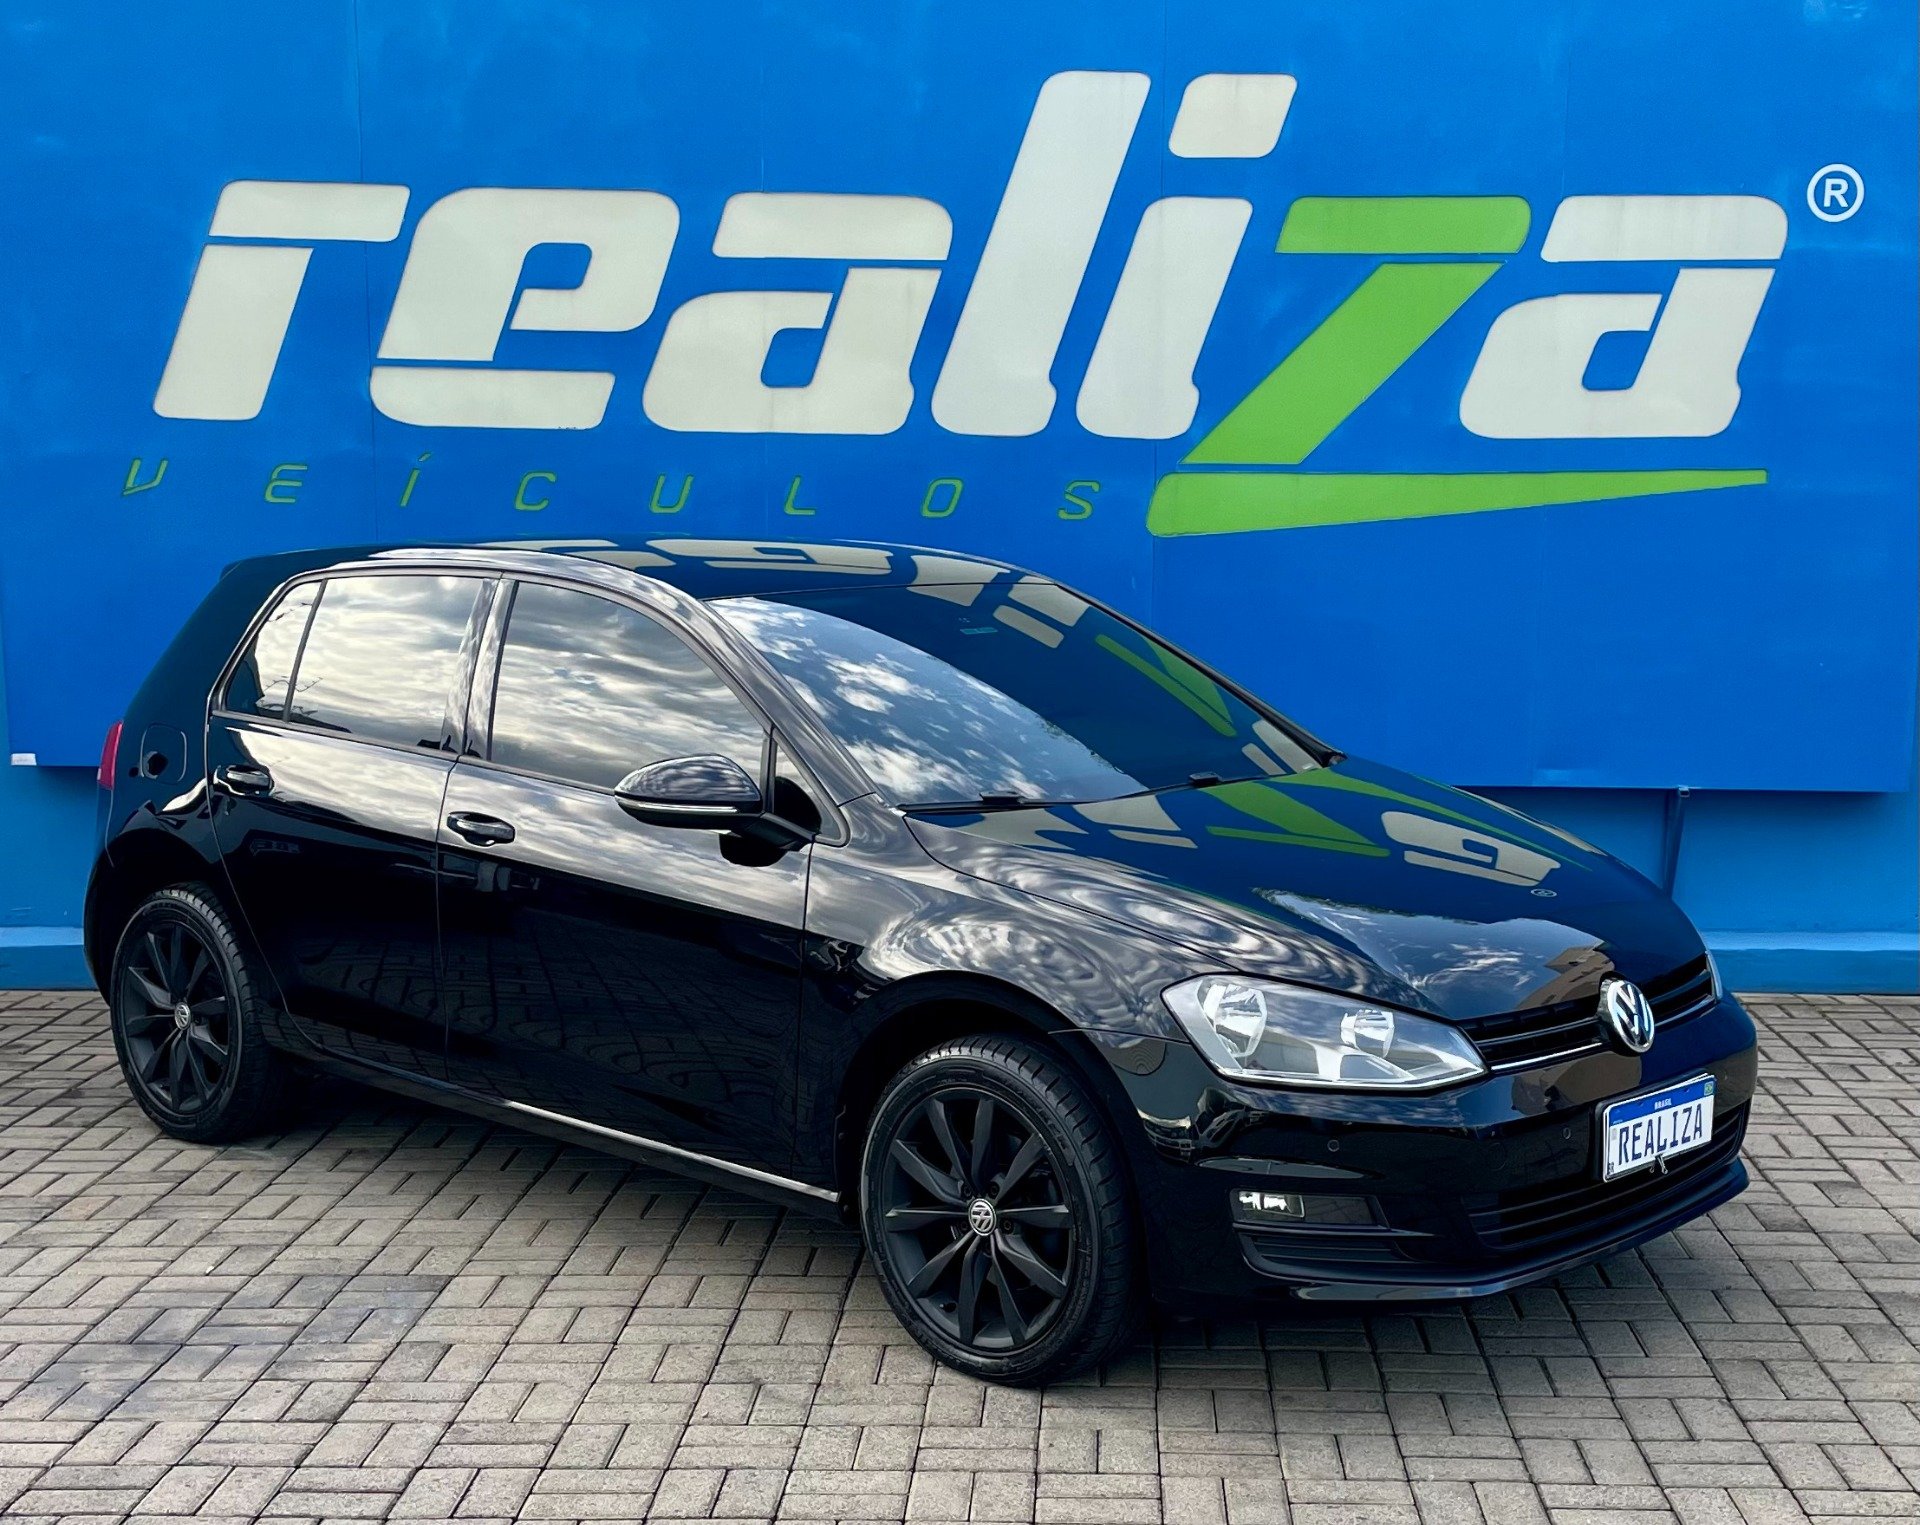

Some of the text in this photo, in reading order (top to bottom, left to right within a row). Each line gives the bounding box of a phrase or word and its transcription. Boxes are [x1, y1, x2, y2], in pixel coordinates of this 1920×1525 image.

[153, 71, 1789, 537] realiza
[122, 451, 1101, 520] VEÍCULOS
[1618, 1103, 1704, 1166] REALIZA
